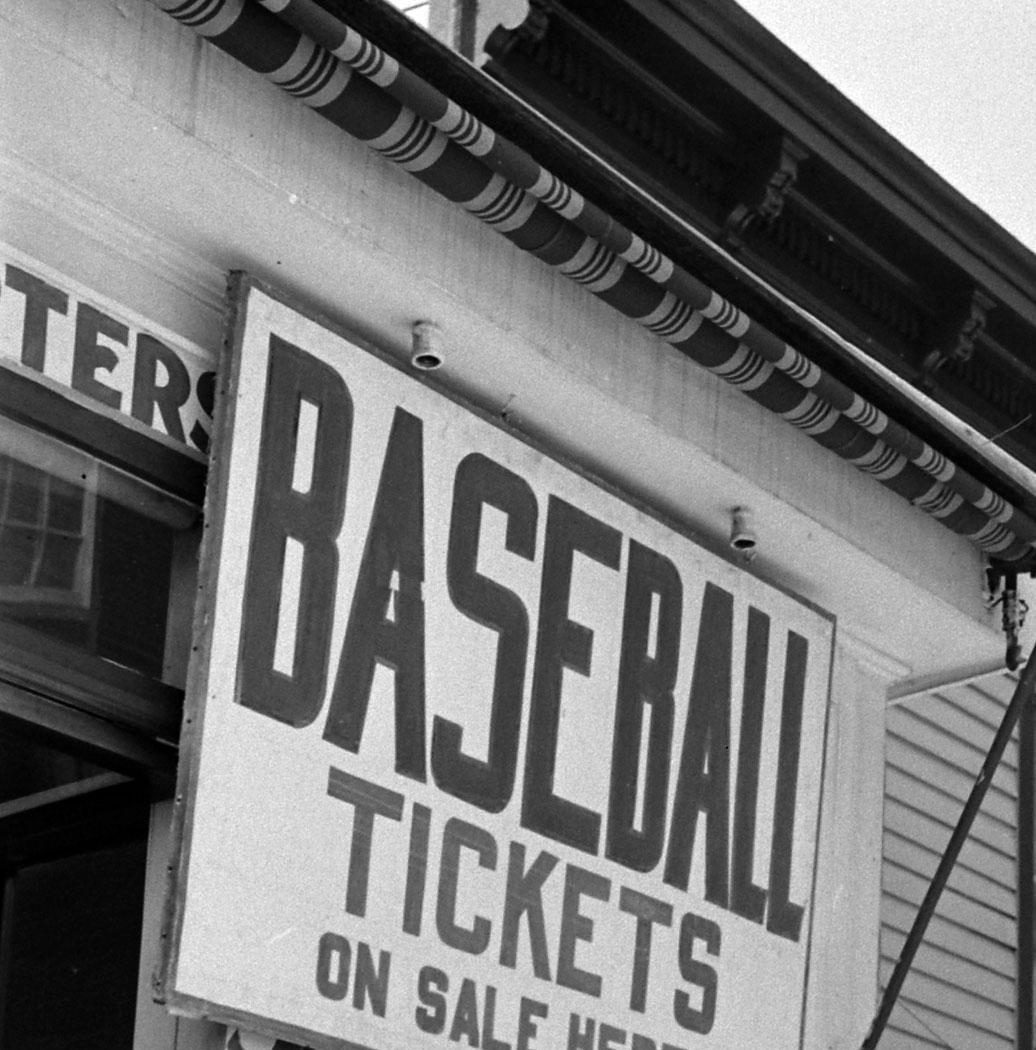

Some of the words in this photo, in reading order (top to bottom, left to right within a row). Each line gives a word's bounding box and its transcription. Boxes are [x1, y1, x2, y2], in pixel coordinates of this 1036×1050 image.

[234, 333, 809, 943] BASEBALL
[315, 931, 391, 1018] ON
[327, 766, 722, 1035] TICKETS
